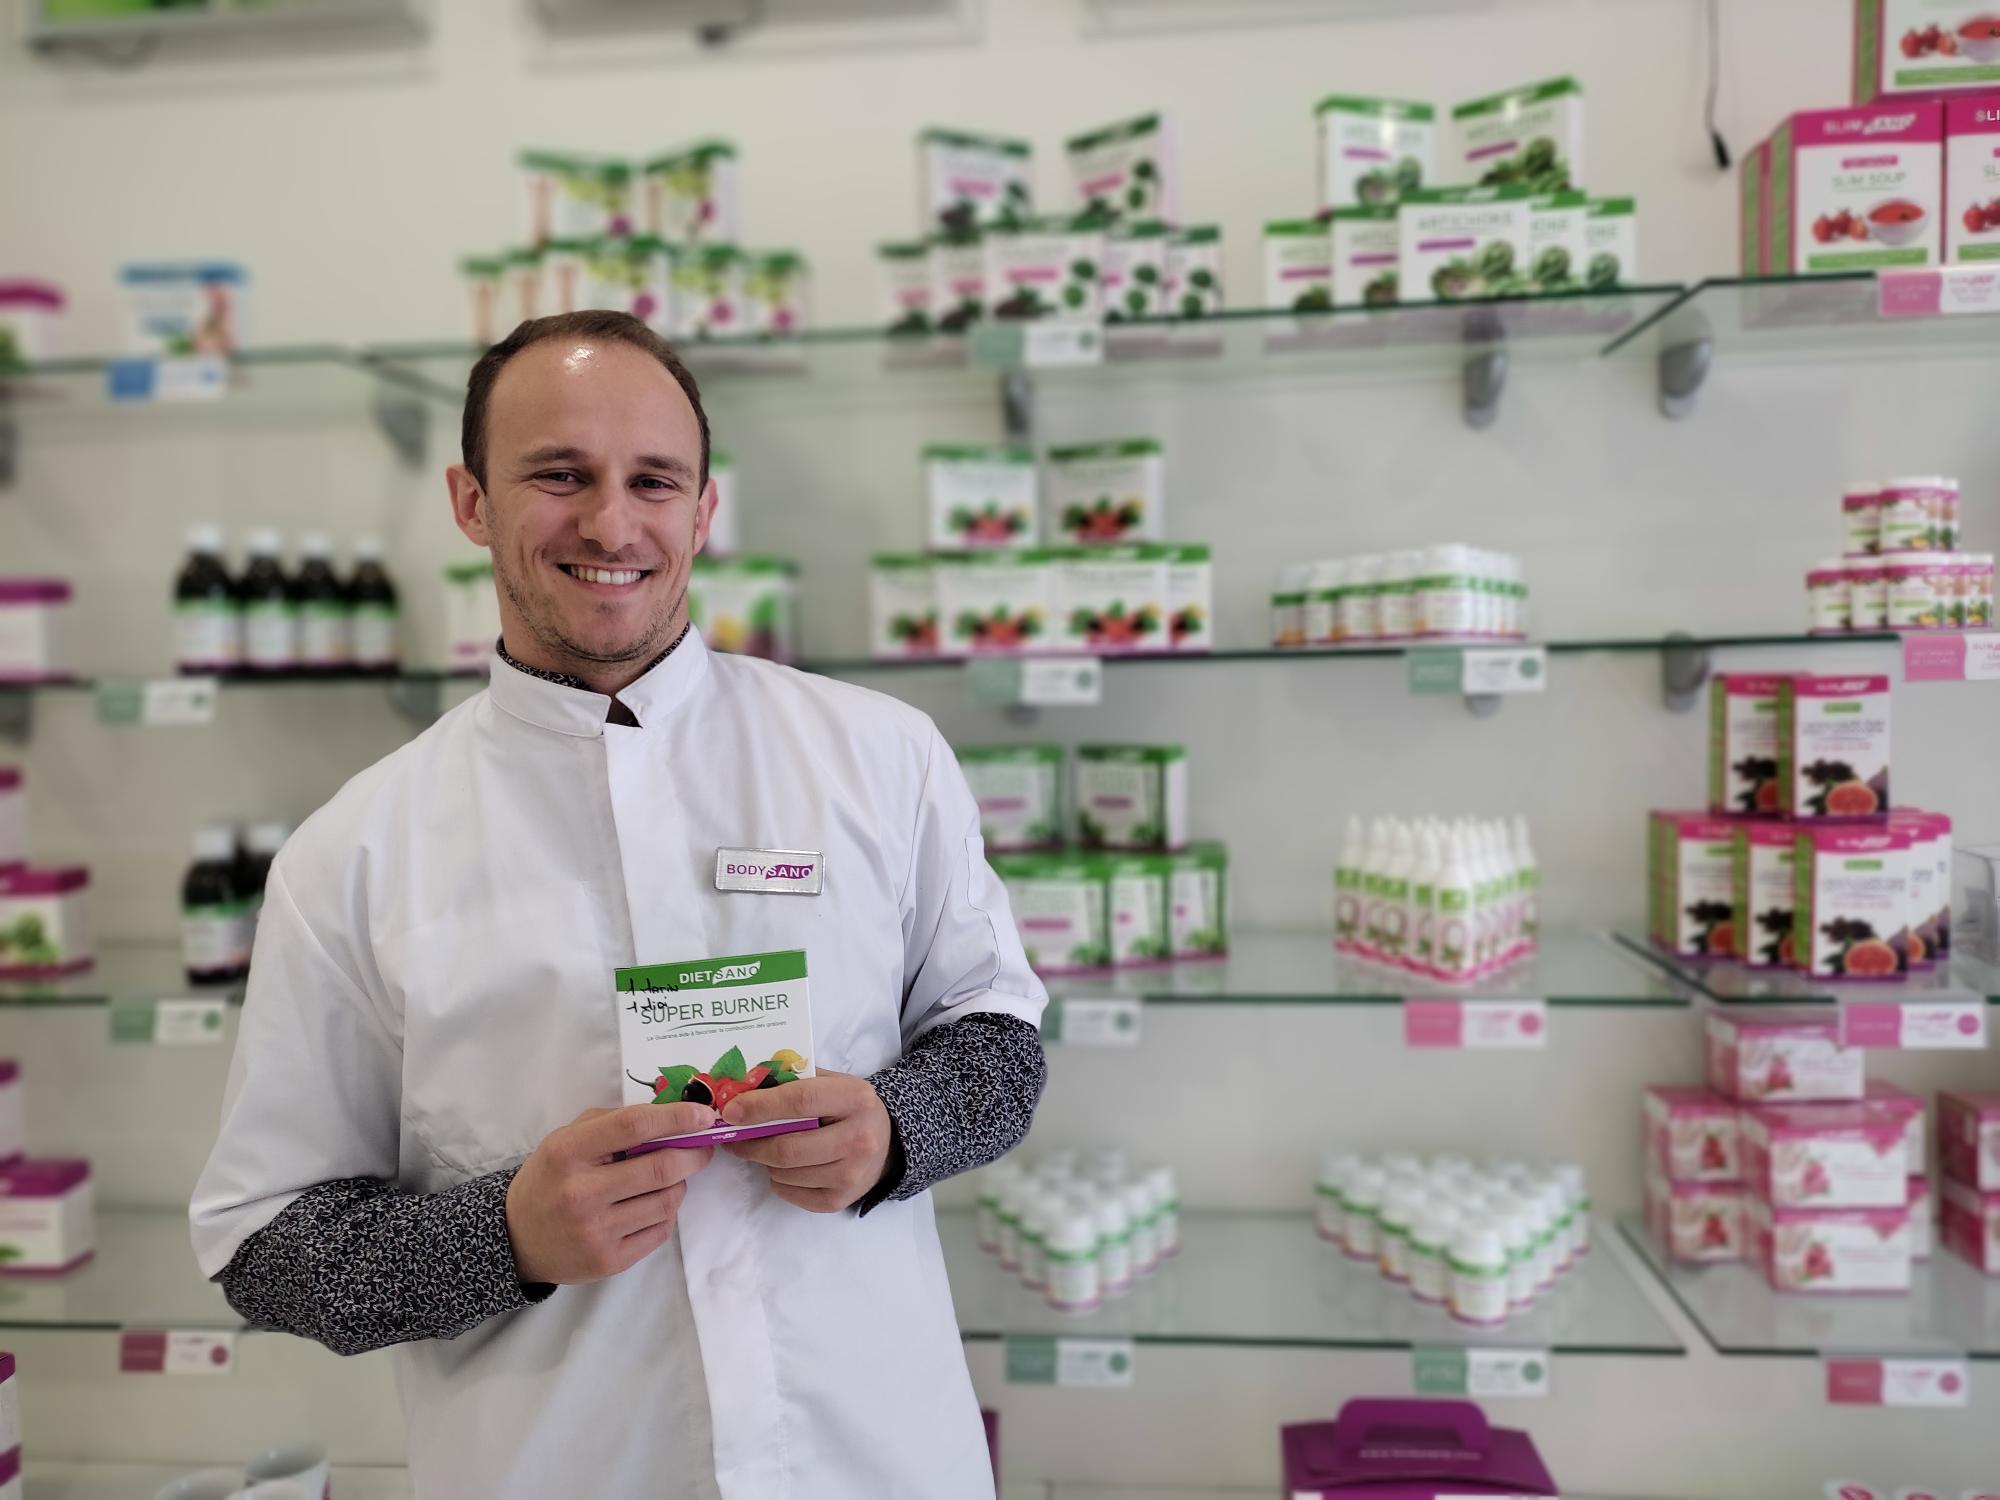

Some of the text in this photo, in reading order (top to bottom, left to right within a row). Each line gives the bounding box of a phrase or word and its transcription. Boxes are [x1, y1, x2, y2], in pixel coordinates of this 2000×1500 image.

[727, 863, 813, 880] BODYSANO
[679, 961, 760, 985] DIETSANO
[641, 994, 789, 1025] SUPER BURNER
